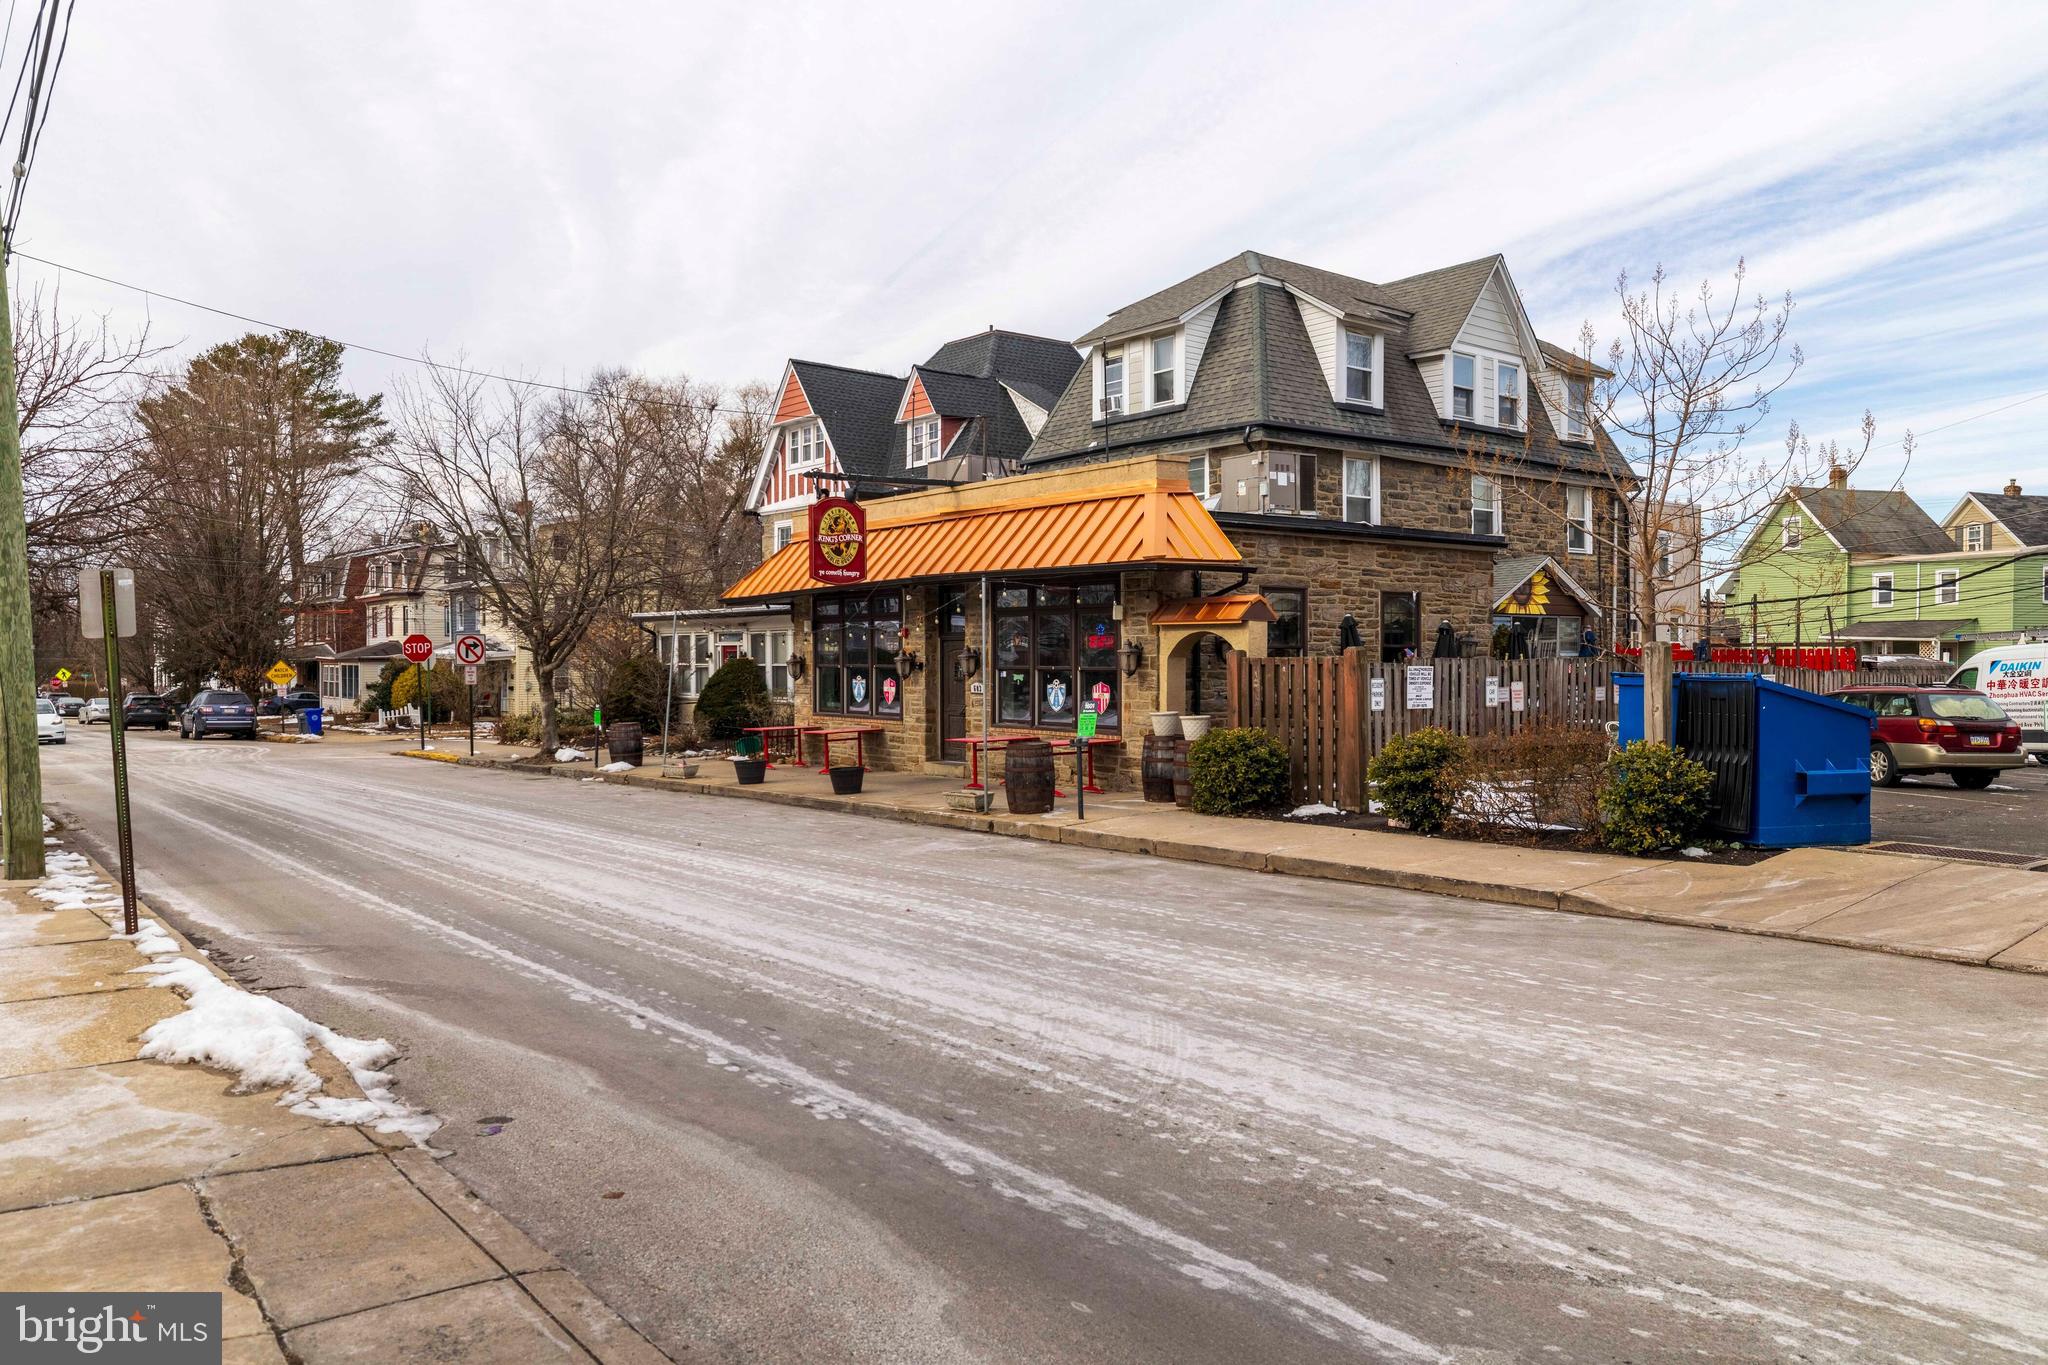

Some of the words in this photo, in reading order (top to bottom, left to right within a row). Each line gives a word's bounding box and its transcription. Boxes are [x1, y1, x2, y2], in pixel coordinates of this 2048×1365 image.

[818, 534, 838, 542] KING'S
[838, 534, 862, 542] CORNER
[842, 569, 860, 578] hungry
[405, 642, 430, 654] STOP
[2000, 661, 2042, 671] DAIKIN
